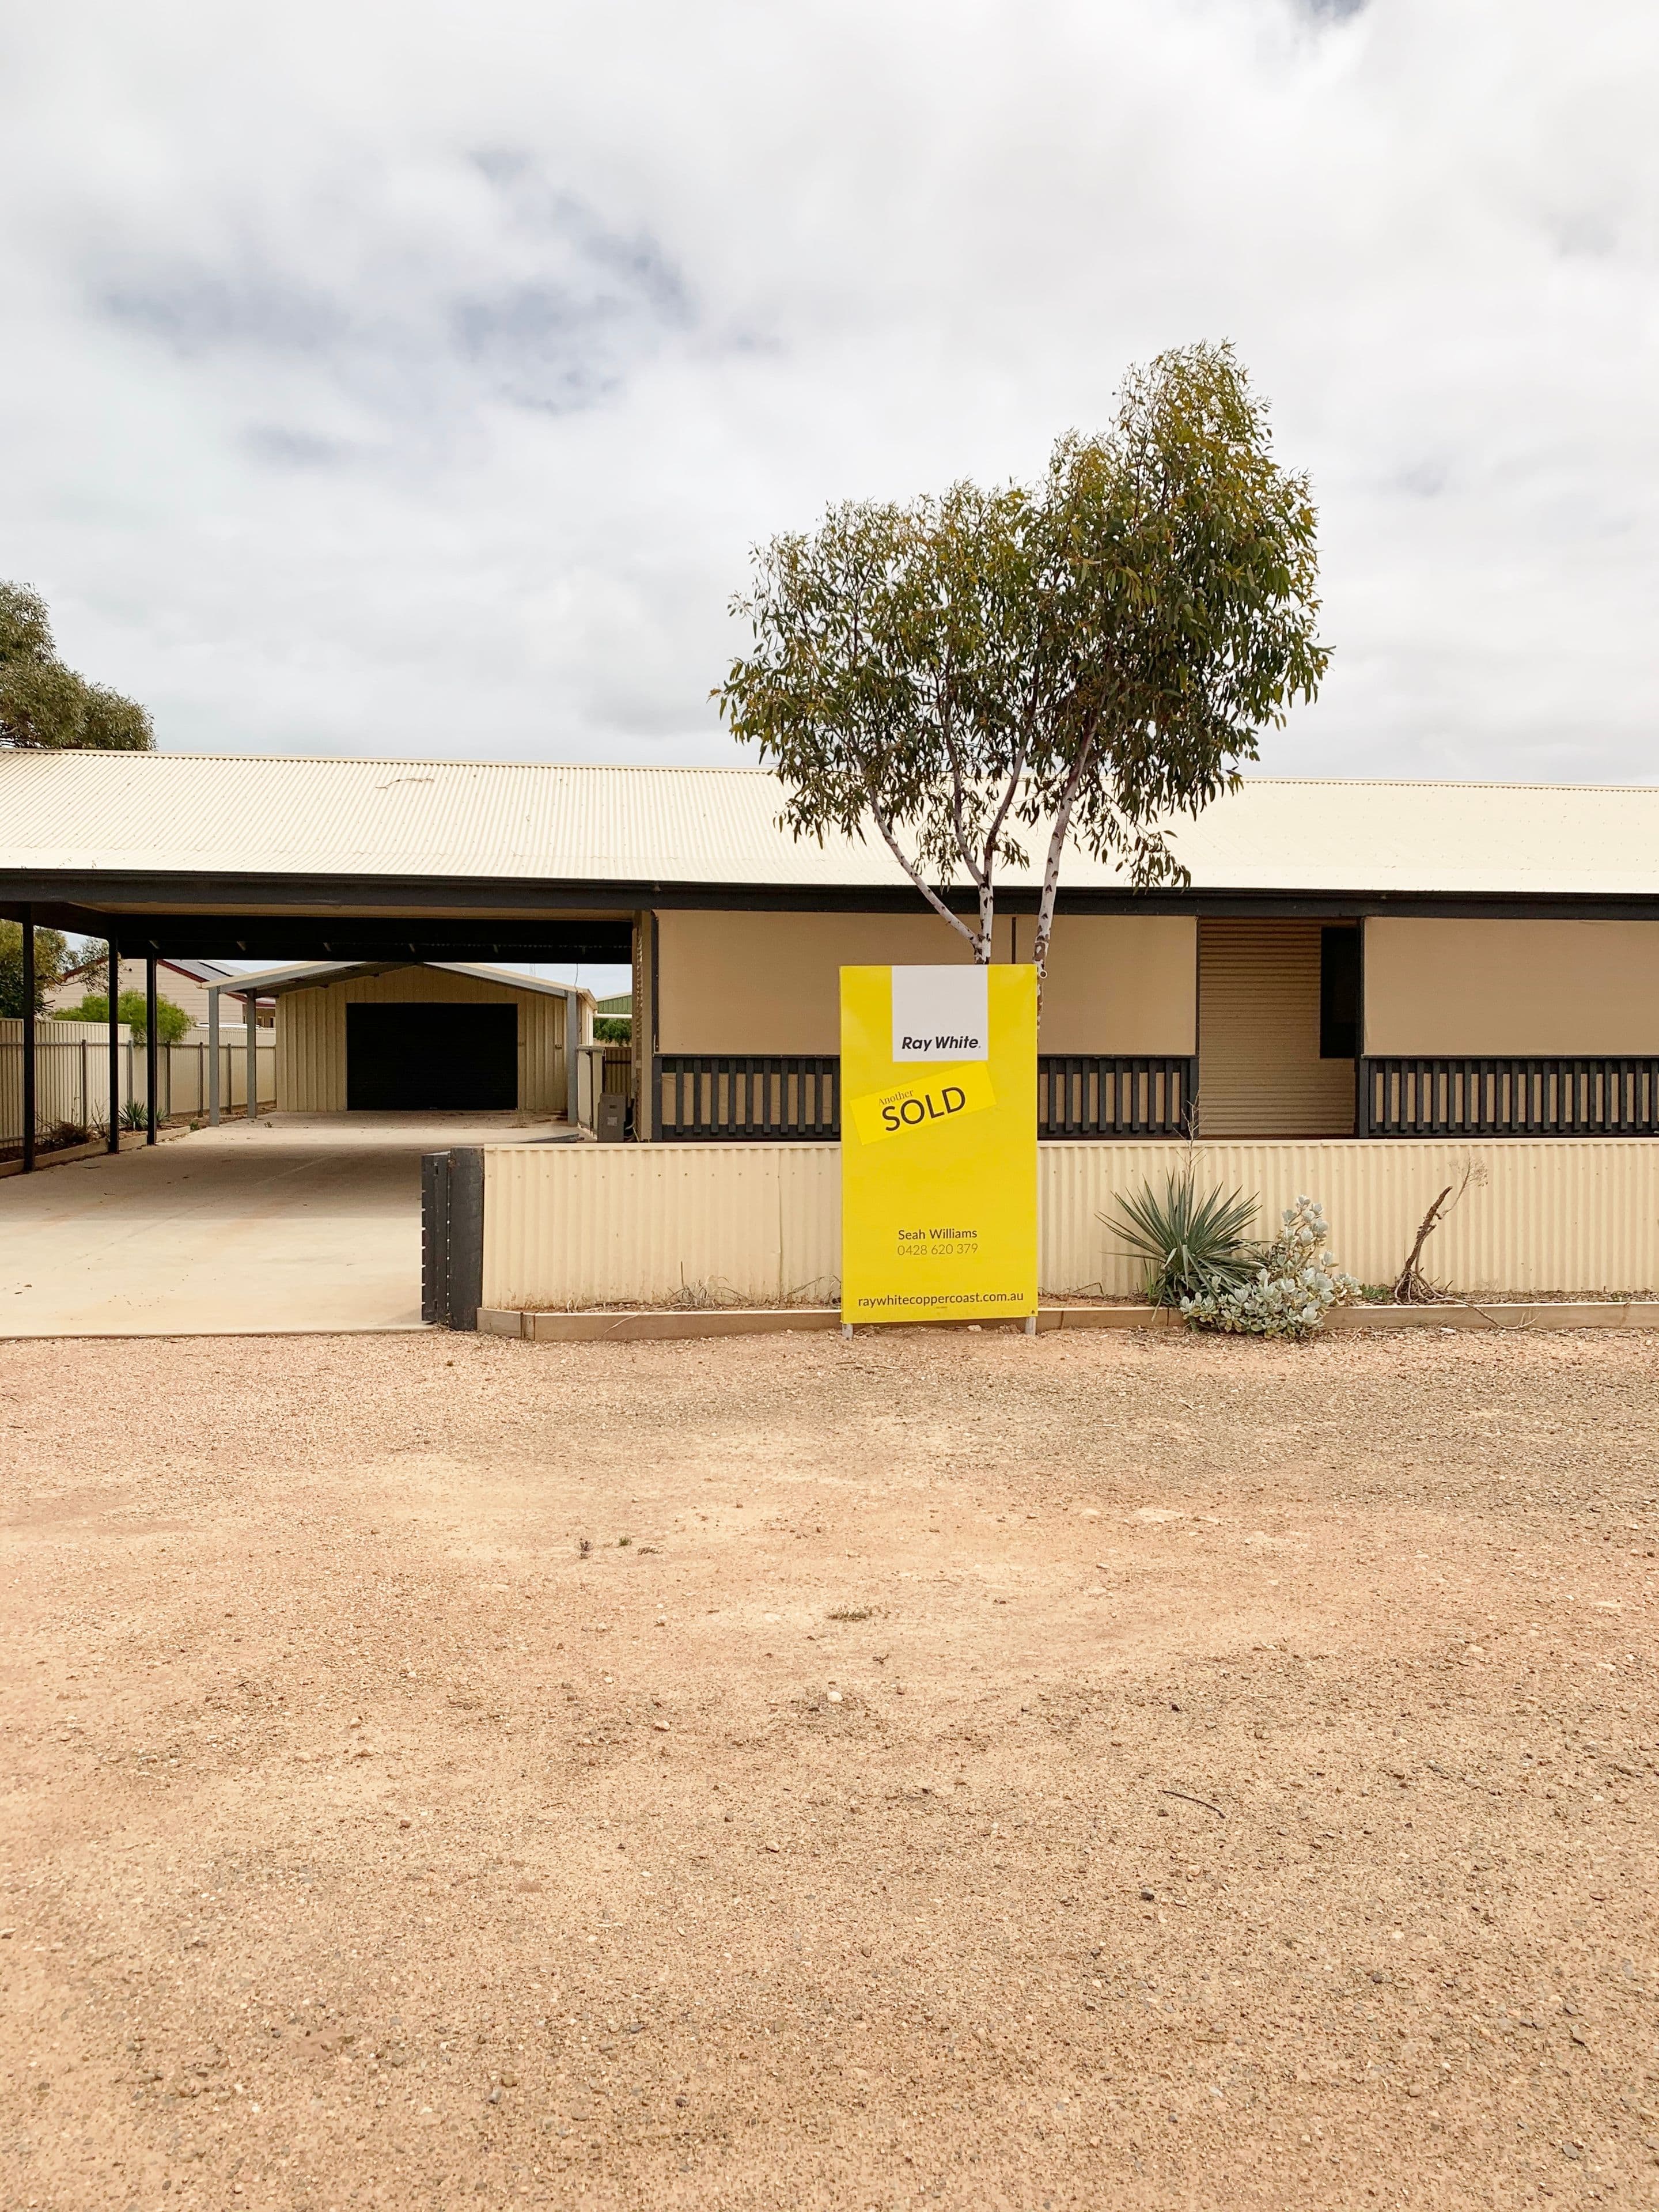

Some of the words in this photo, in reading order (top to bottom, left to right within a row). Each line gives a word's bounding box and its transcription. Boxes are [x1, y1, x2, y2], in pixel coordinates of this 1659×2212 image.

[902, 1036, 932, 1051] Ray
[878, 1089, 914, 1106] Another
[882, 1087, 965, 1131] SOLD
[898, 1229, 926, 1240] Seah
[929, 1228, 978, 1239] Williams
[897, 1244, 927, 1255] 0428
[931, 1244, 953, 1255] 620
[957, 1243, 978, 1254] 379
[858, 1292, 1023, 1308] raywhitecoppercoast.com.au
